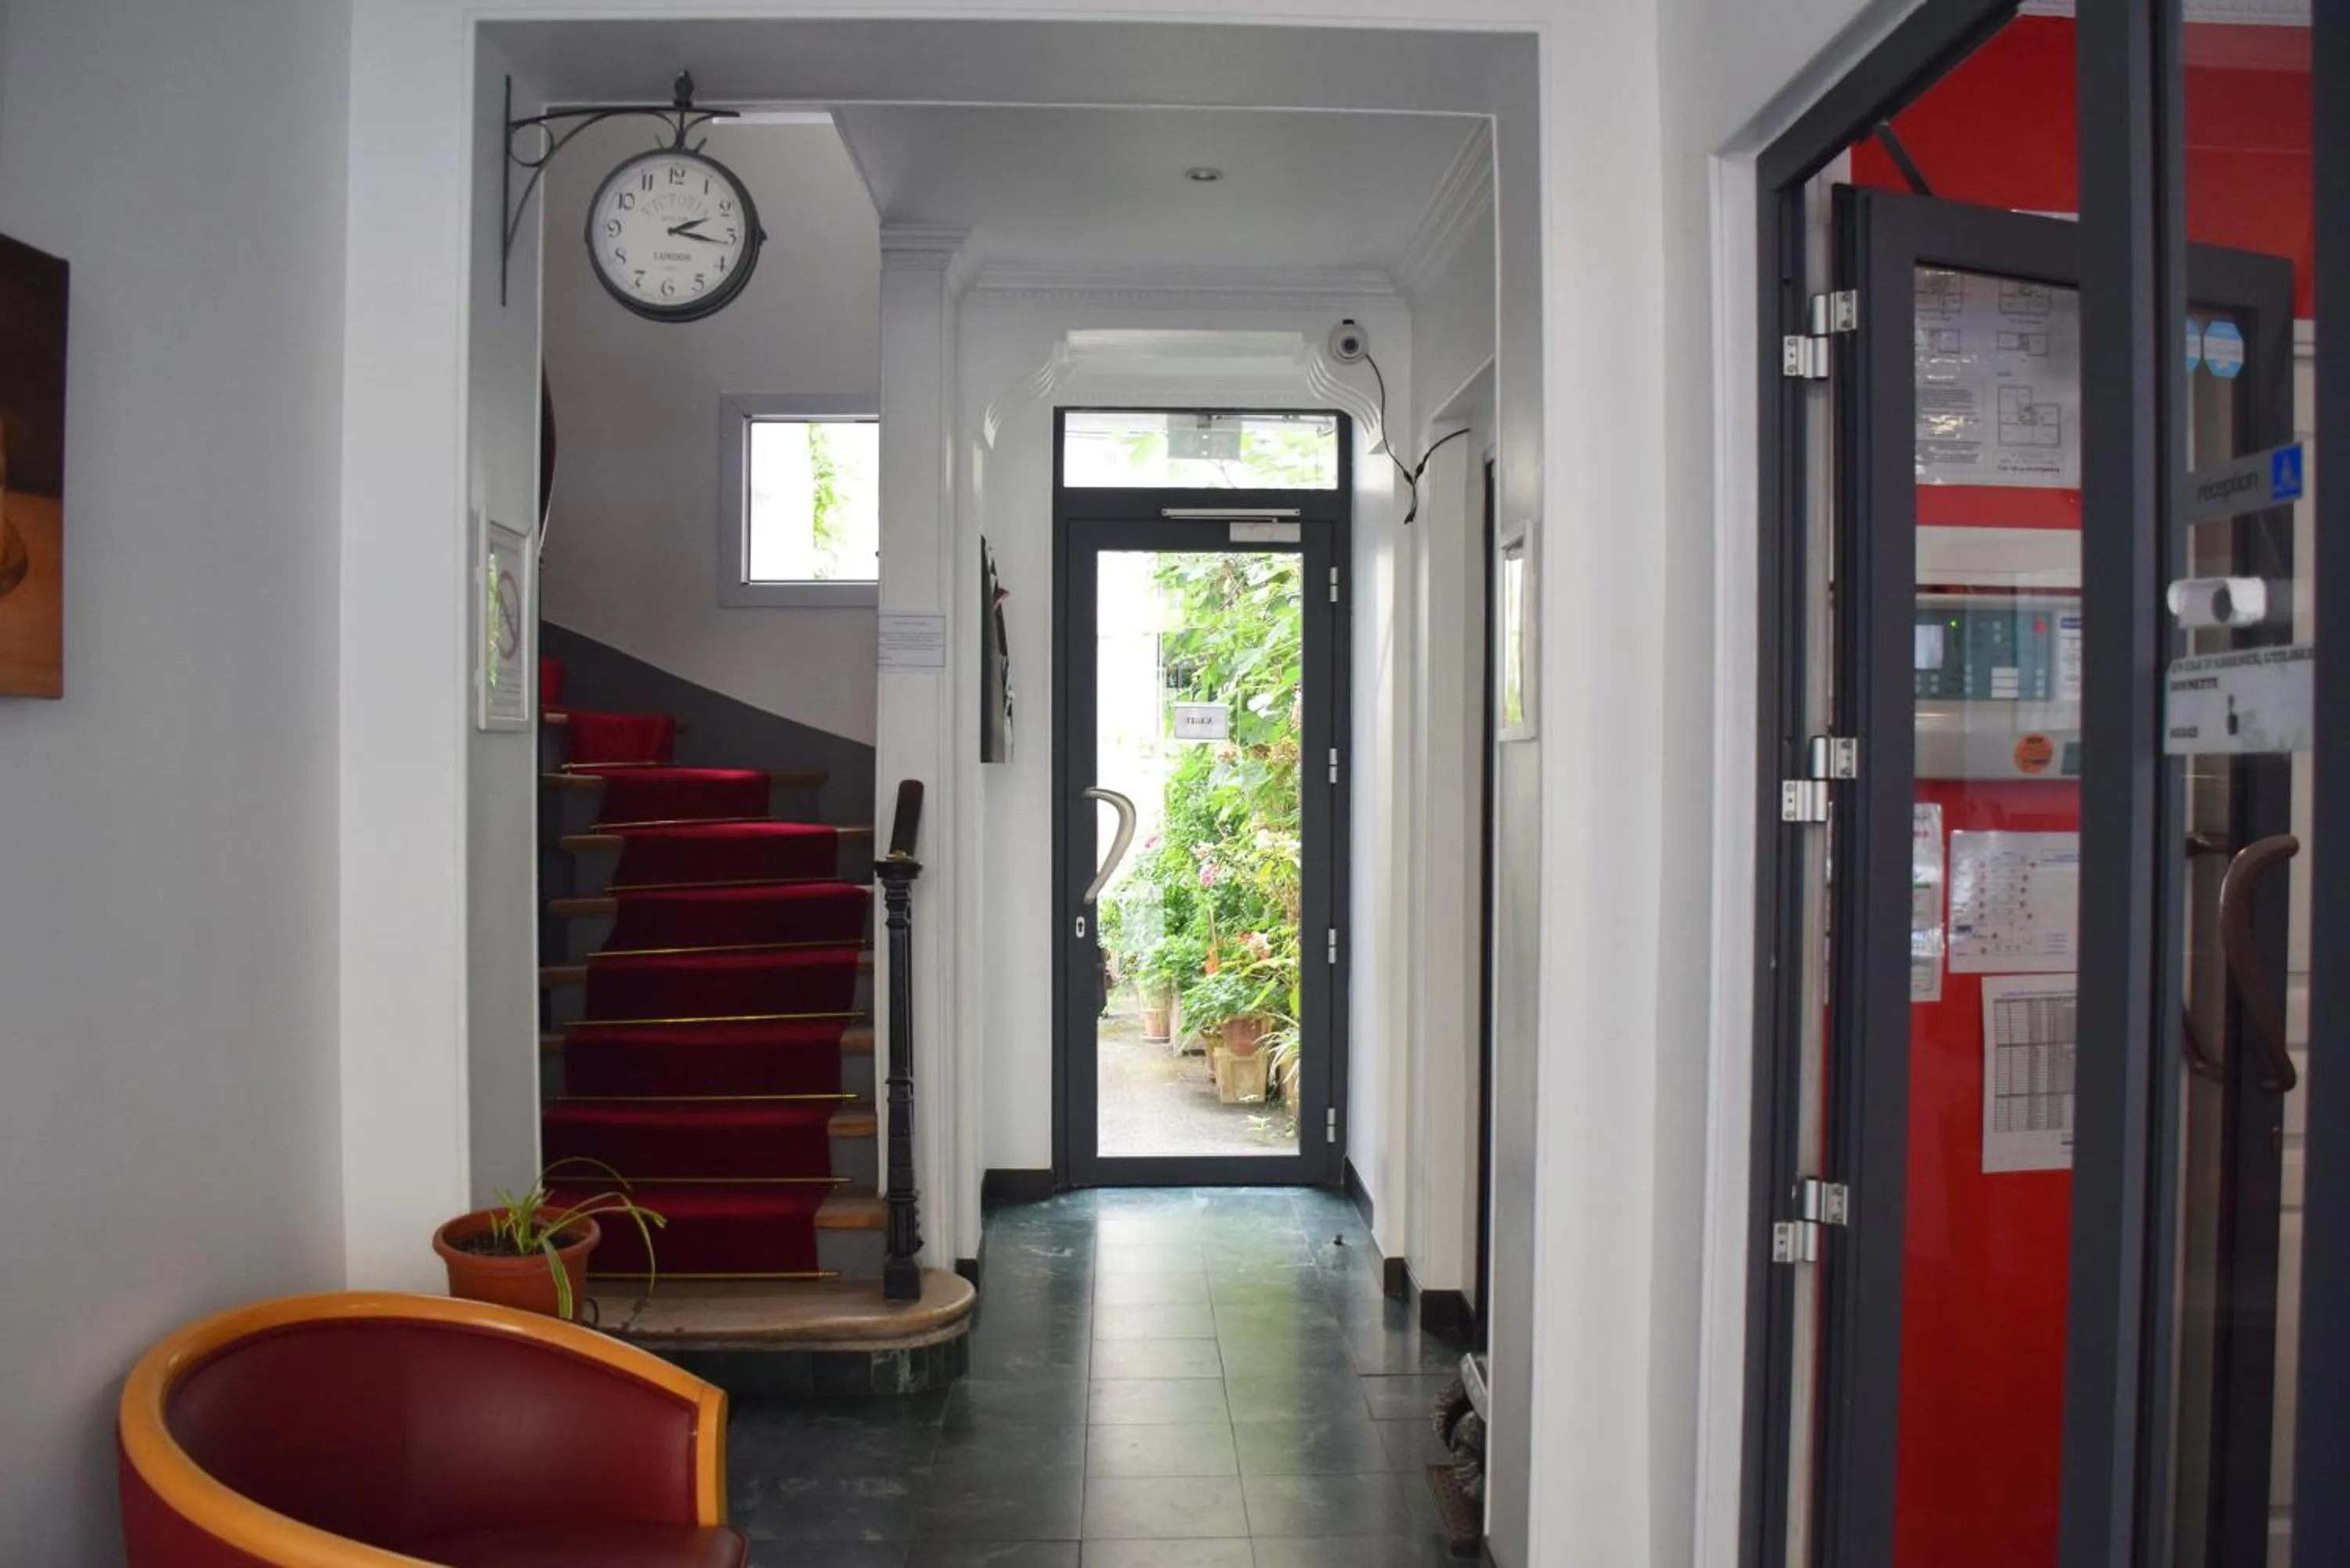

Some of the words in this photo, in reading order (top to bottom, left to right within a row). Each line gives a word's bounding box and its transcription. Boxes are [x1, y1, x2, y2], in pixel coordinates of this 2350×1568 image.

[641, 174, 654, 191] 11
[669, 167, 686, 186] 12
[704, 179, 710, 196] 1
[618, 193, 635, 210] 10
[718, 200, 732, 218] 2
[606, 219, 622, 238] 9
[726, 227, 738, 246] 3
[614, 248, 627, 265] 8
[653, 251, 692, 262] LONDON
[714, 255, 728, 273] 4
[633, 269, 645, 288] 7
[691, 273, 705, 293] 5
[660, 279, 676, 297] 6
